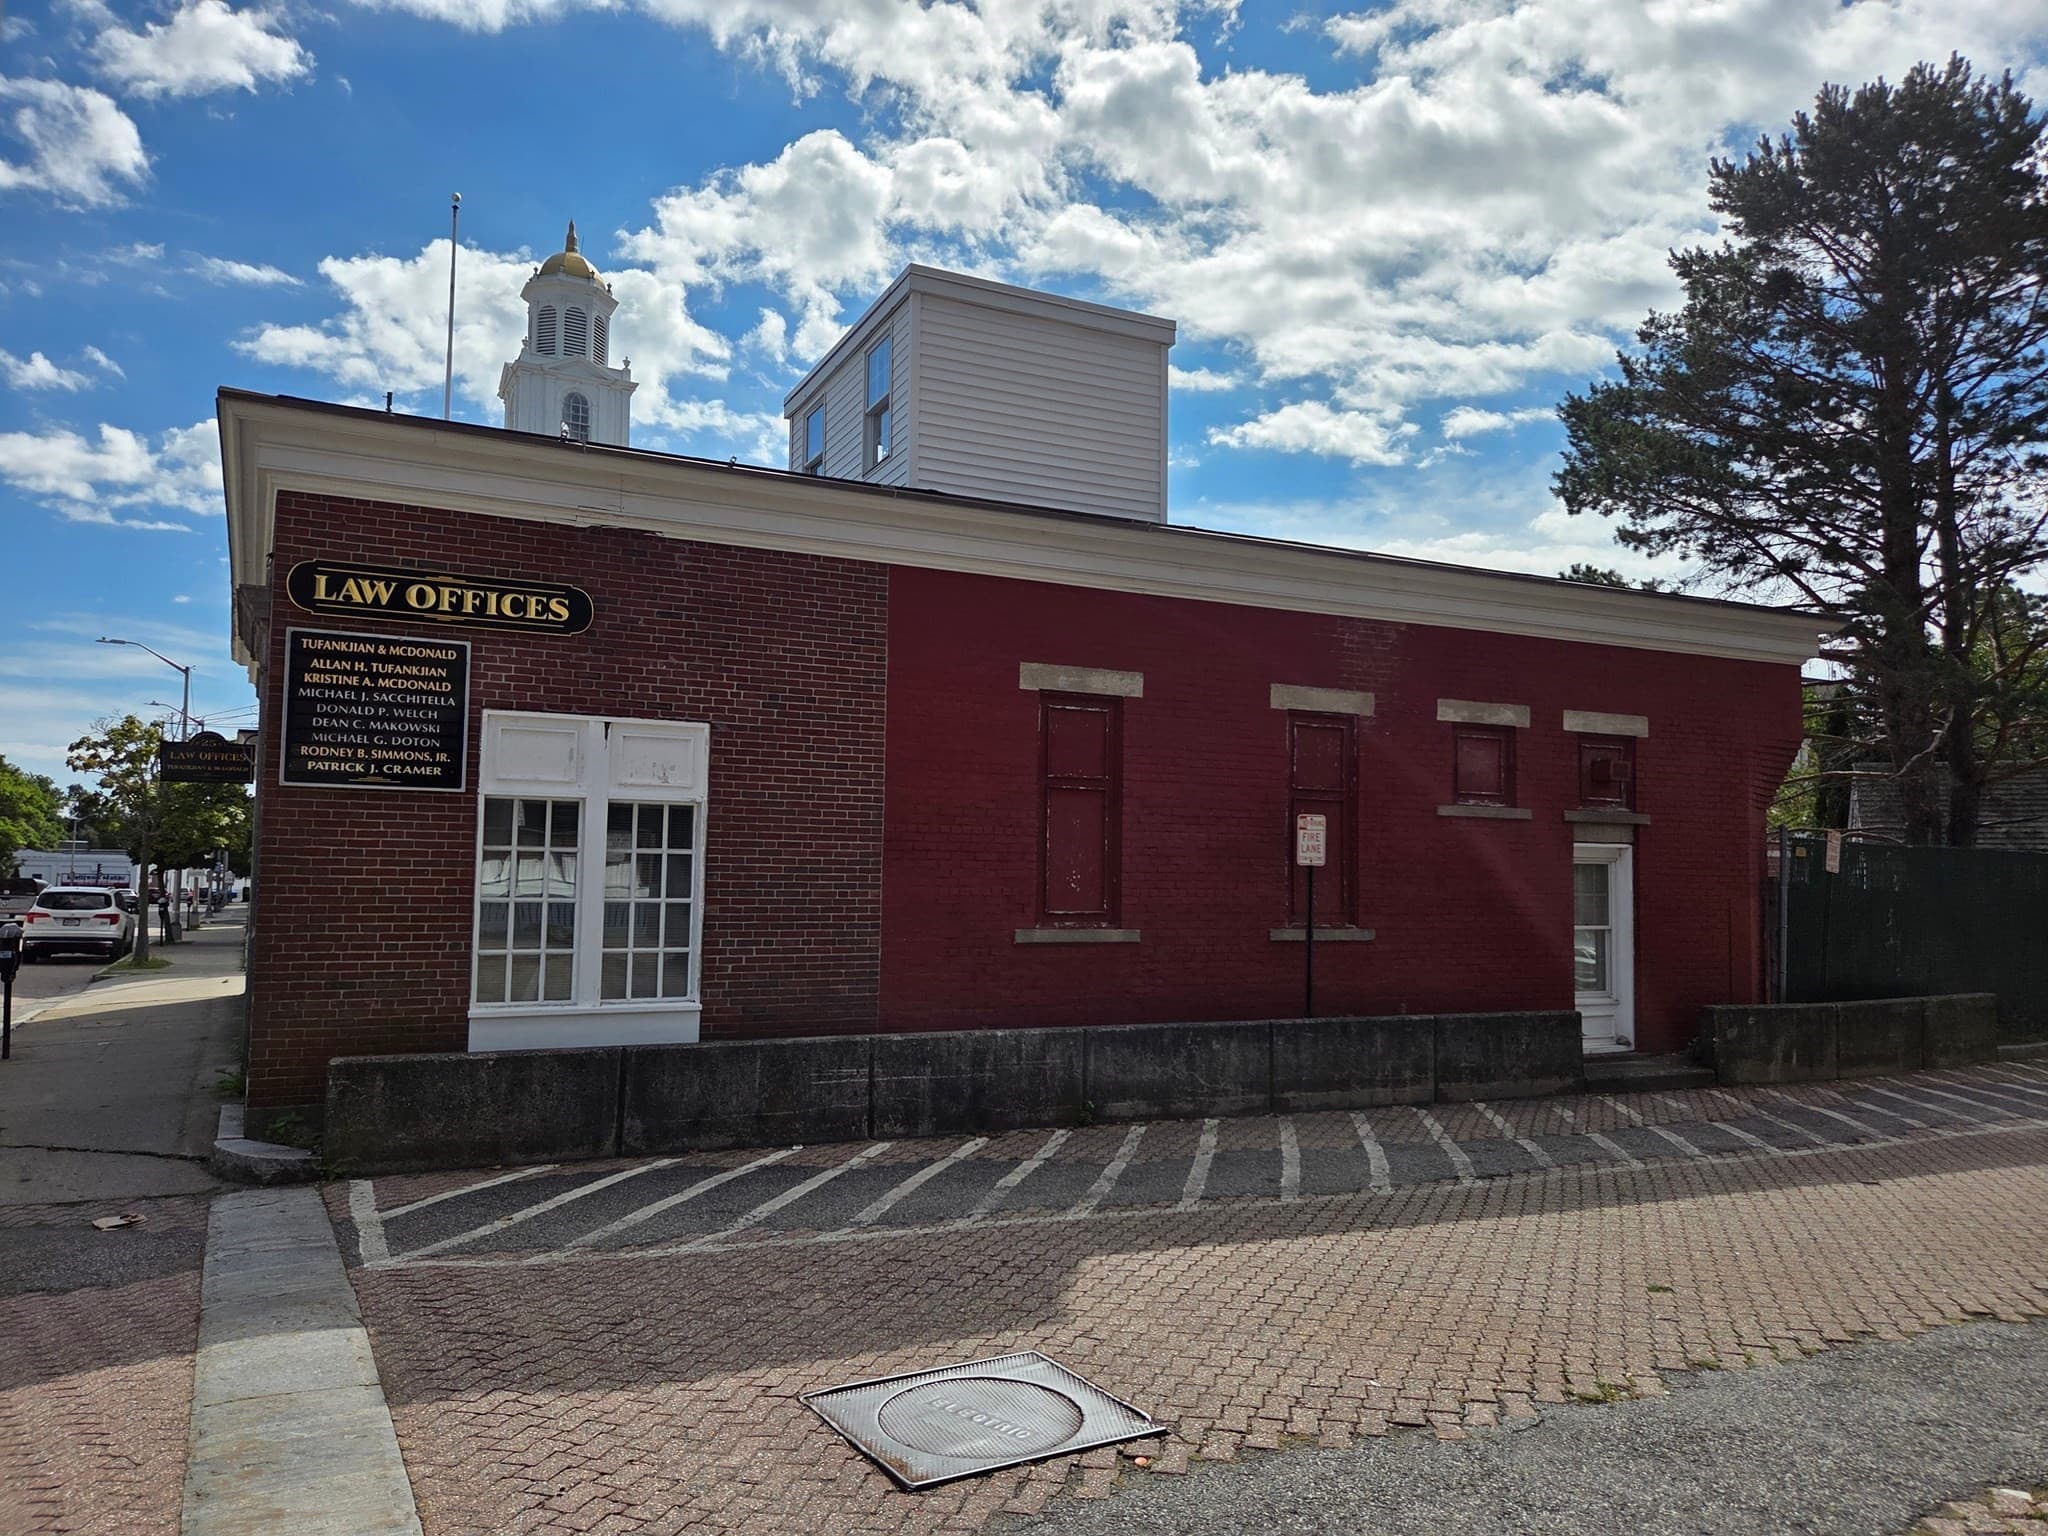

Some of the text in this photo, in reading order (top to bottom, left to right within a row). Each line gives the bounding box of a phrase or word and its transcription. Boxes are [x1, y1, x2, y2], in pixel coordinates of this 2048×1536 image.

[313, 574, 570, 622] LAW OFFICES
[301, 638, 457, 660] TUFANKJIAN & MCDONALD
[310, 658, 447, 678] ALLAN H. TUFANKJIAN
[303, 672, 452, 692] KRISTINE A. MCDONALD
[298, 687, 456, 707] MICHAEL J. SACCHITELLA
[316, 703, 438, 719] DONALD P. WELCH
[312, 717, 440, 734] DEAN C. MAKOWSKI
[312, 732, 440, 747] MICHAEL G. DOTON
[169, 751, 246, 762] LAW OFFICES
[300, 745, 451, 762] RODNEY B. SIMMONS, JR.
[307, 761, 442, 776] PATRICK J. CRAMER
[1302, 832, 1321, 842] FIRE
[1301, 844, 1321, 854] LANE
